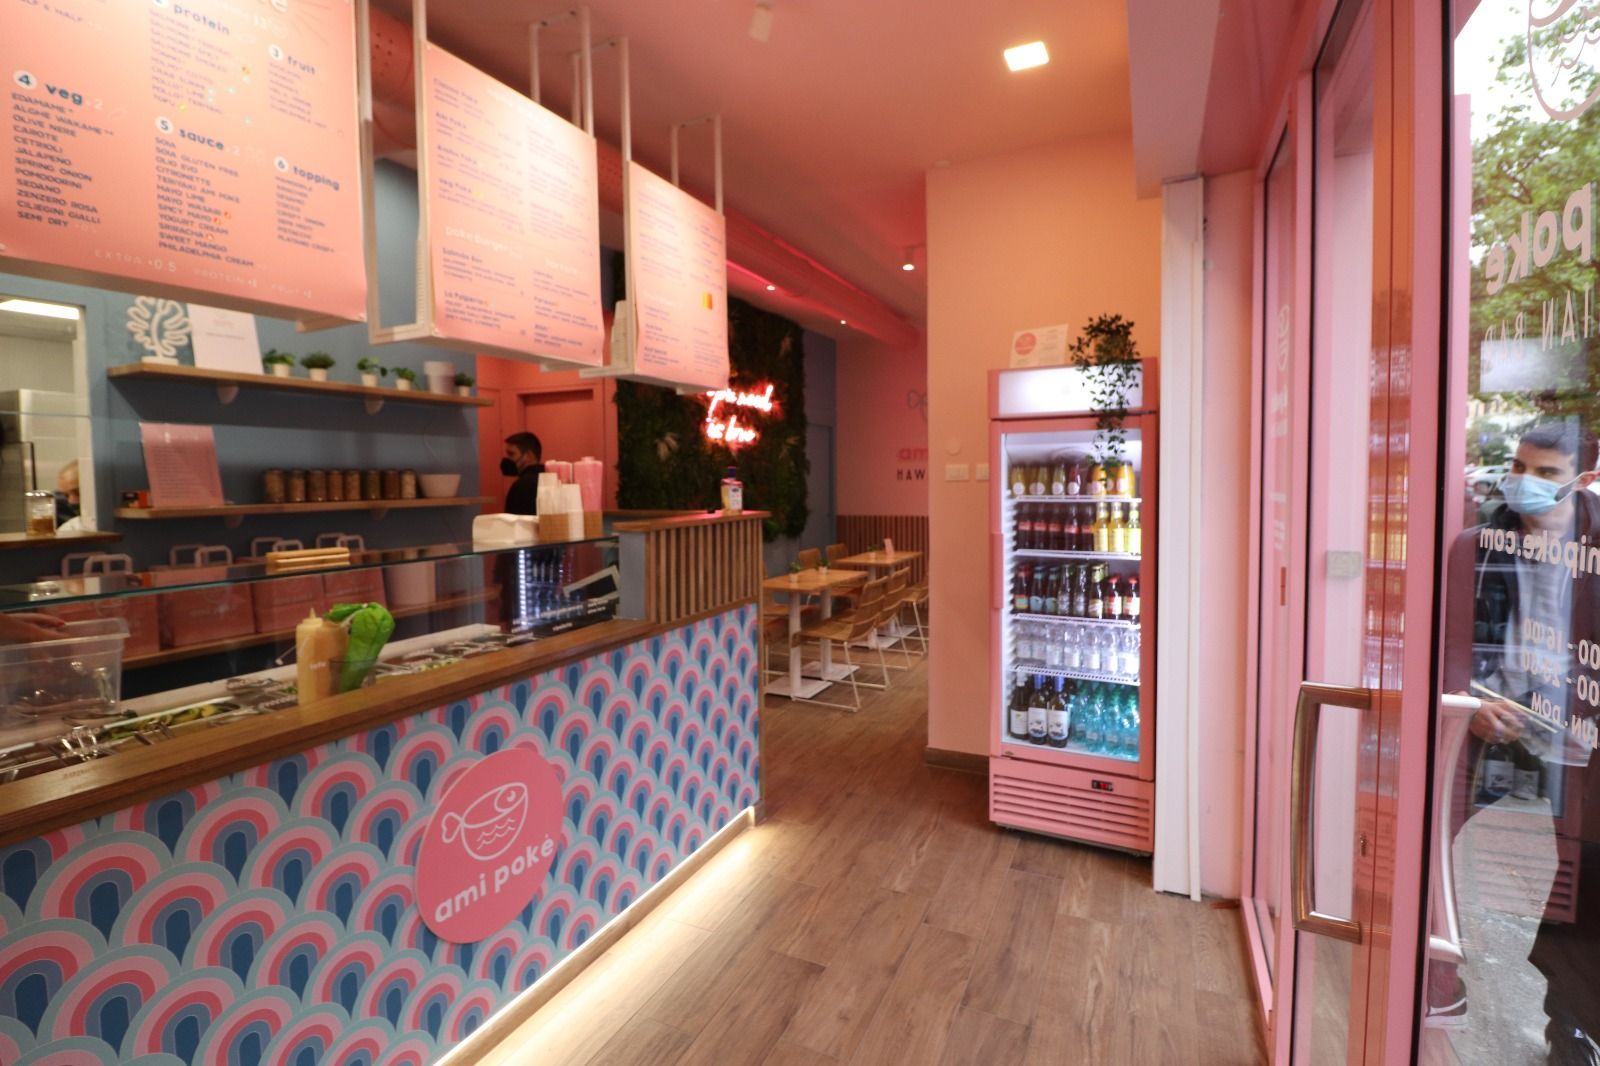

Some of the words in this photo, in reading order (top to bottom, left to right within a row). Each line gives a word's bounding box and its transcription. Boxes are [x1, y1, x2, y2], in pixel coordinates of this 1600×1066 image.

[174, 4, 230, 35] protein
[287, 55, 316, 75] fruit
[18, 74, 31, 87] 4
[44, 83, 84, 106] veg
[11, 92, 65, 113] EDAMAME
[12, 114, 44, 128] OLIVE
[49, 123, 77, 137] NERE
[13, 104, 50, 119] ALGHE
[56, 115, 102, 135] WAKAME
[13, 124, 58, 142] CAROTE
[13, 135, 63, 153] CETRIOLI
[155, 137, 177, 149] SOIA
[159, 120, 170, 132] 5
[179, 129, 225, 151] sauce
[15, 146, 72, 166] JALAPENO
[155, 147, 177, 158] SOIA
[180, 154, 217, 170] GLUTEN
[218, 166, 240, 177] FREE
[155, 156, 178, 168] OLIO
[180, 163, 199, 174] EVO
[15, 156, 55, 172] SPRING
[59, 167, 92, 182] ONION
[15, 167, 82, 189] POMODORINI
[155, 165, 211, 187] CITRONETTE
[278, 160, 286, 170] 6
[293, 166, 340, 191] topping
[16, 178, 61, 194] SEDANO
[157, 175, 197, 191] TERIYAKI
[157, 184, 183, 197] MAYO
[186, 193, 206, 203] LIME
[16, 189, 66, 206] ZENZERO
[71, 201, 98, 213] ROSA
[16, 199, 65, 216] CILIEGINI
[68, 211, 101, 224] GIALLI
[157, 194, 184, 206] MAYO
[188, 203, 223, 217] WASABI
[16, 211, 43, 222] SEMI
[48, 217, 69, 228] DRY
[158, 203, 184, 215] SPICY
[187, 211, 213, 223] MAYO
[159, 213, 195, 227] YOGURT
[198, 222, 229, 235] CREAM
[158, 222, 205, 239] SRIRACHA
[159, 231, 192, 245] SWEET
[194, 240, 229, 253] MANGO
[158, 241, 223, 261] PHILADELPHIA
[224, 256, 255, 268] CREAM
[435, 873, 487, 923] ami
